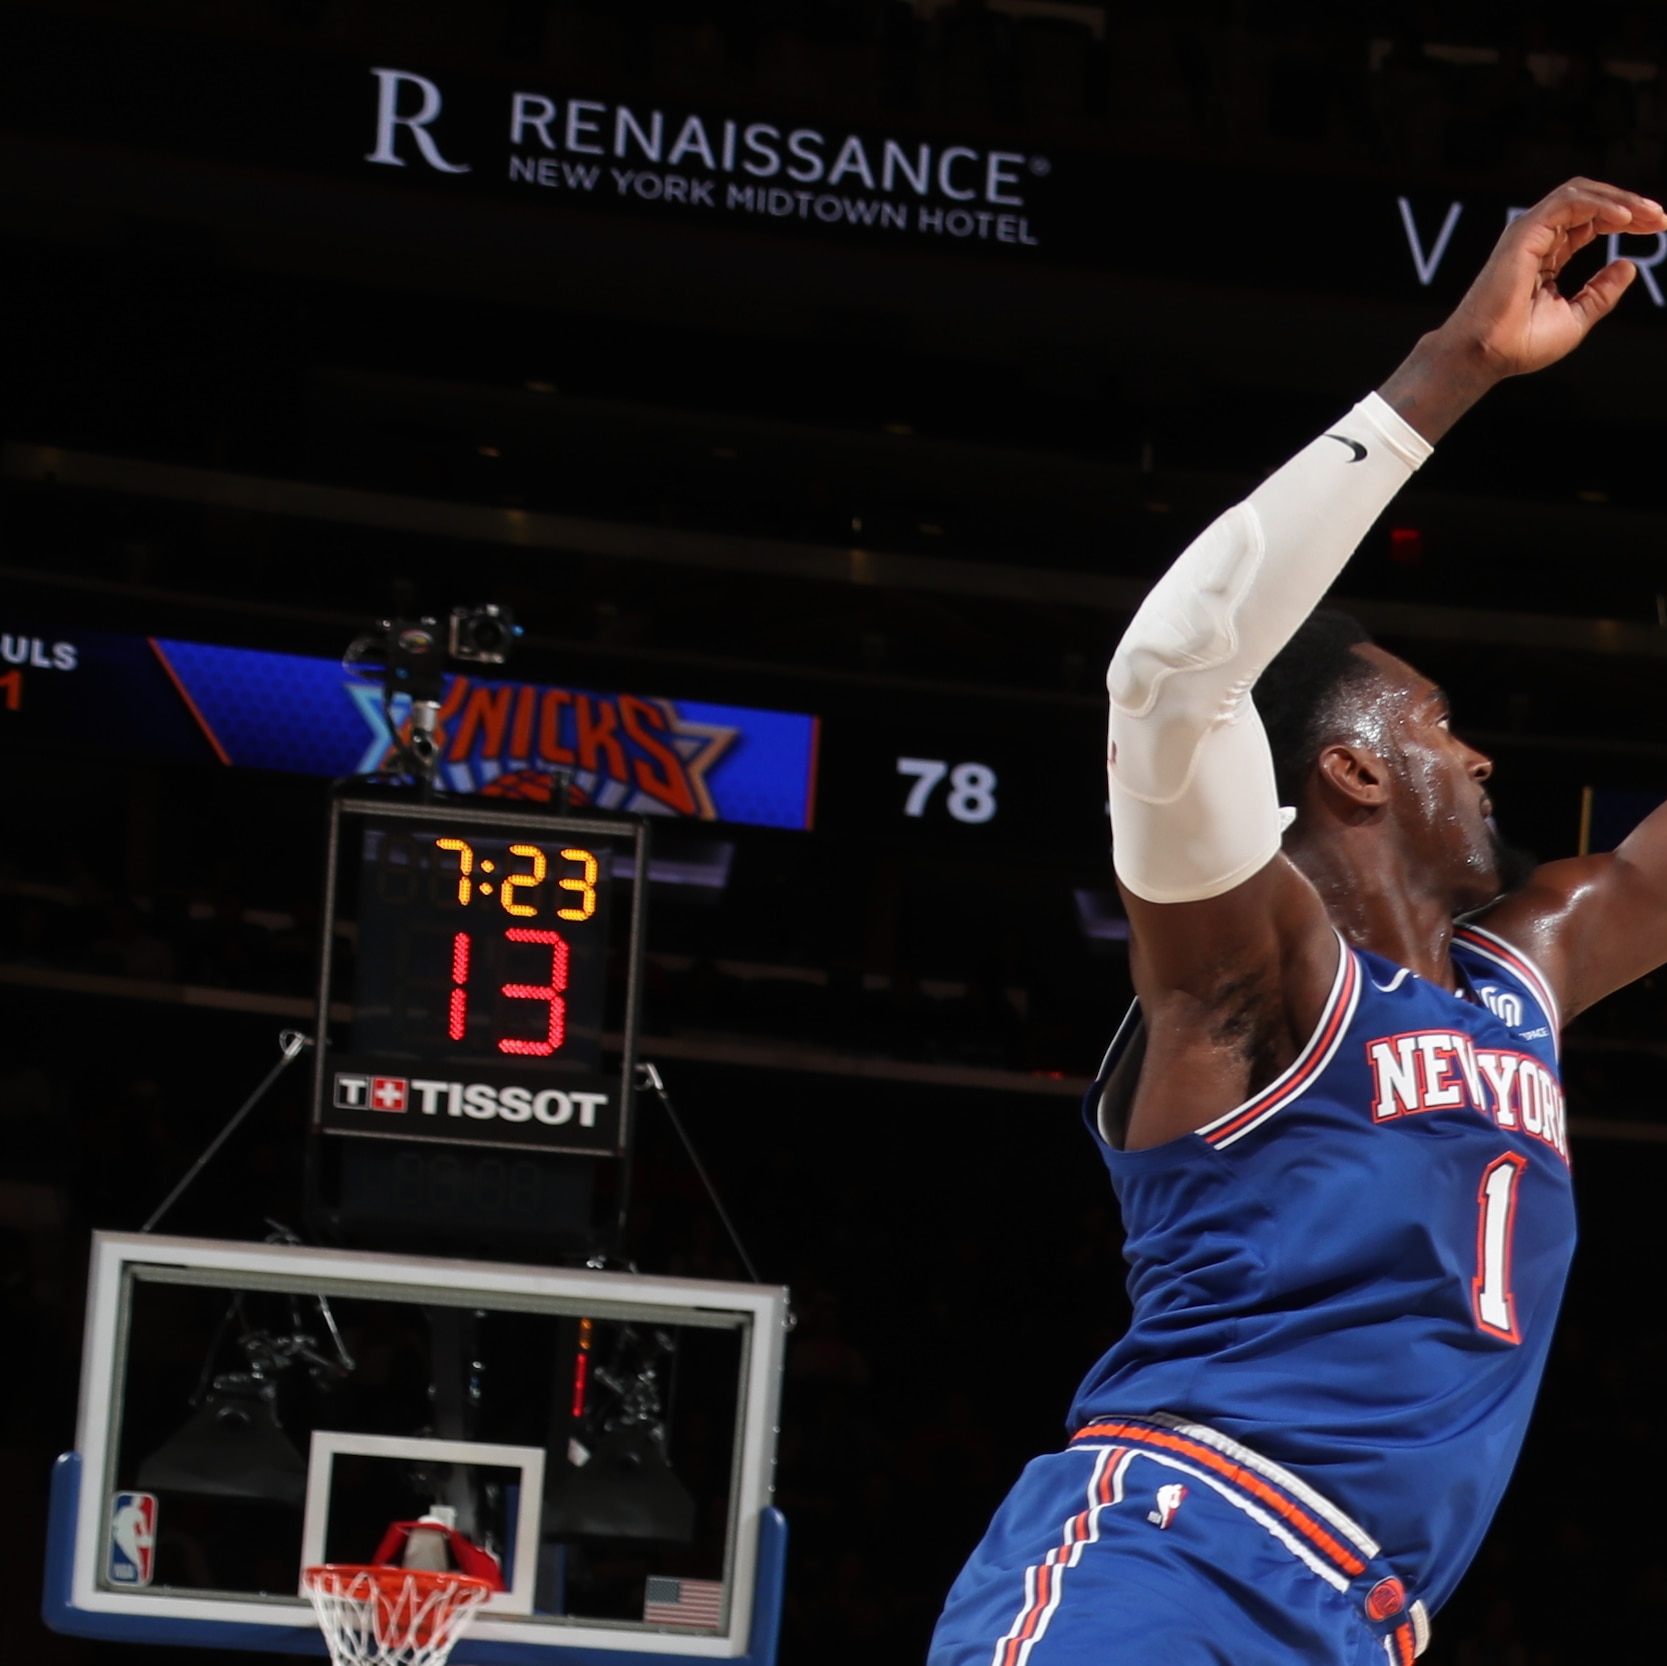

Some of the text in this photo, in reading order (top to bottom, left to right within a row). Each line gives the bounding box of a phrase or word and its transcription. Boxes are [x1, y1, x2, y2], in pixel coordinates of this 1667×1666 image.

[367, 68, 470, 173] R
[510, 92, 1026, 206] RENAISSANCE
[509, 155, 1038, 246] NEW YORK MIDTOWN HOTEL
[0, 633, 79, 671] ULS
[897, 757, 998, 824] 78
[435, 837, 600, 922] 7:23
[448, 927, 571, 1057] 13
[410, 1078, 609, 1128] TISSOT
[1366, 1028, 1489, 1125] NEW
[1471, 1150, 1528, 1346] 1
